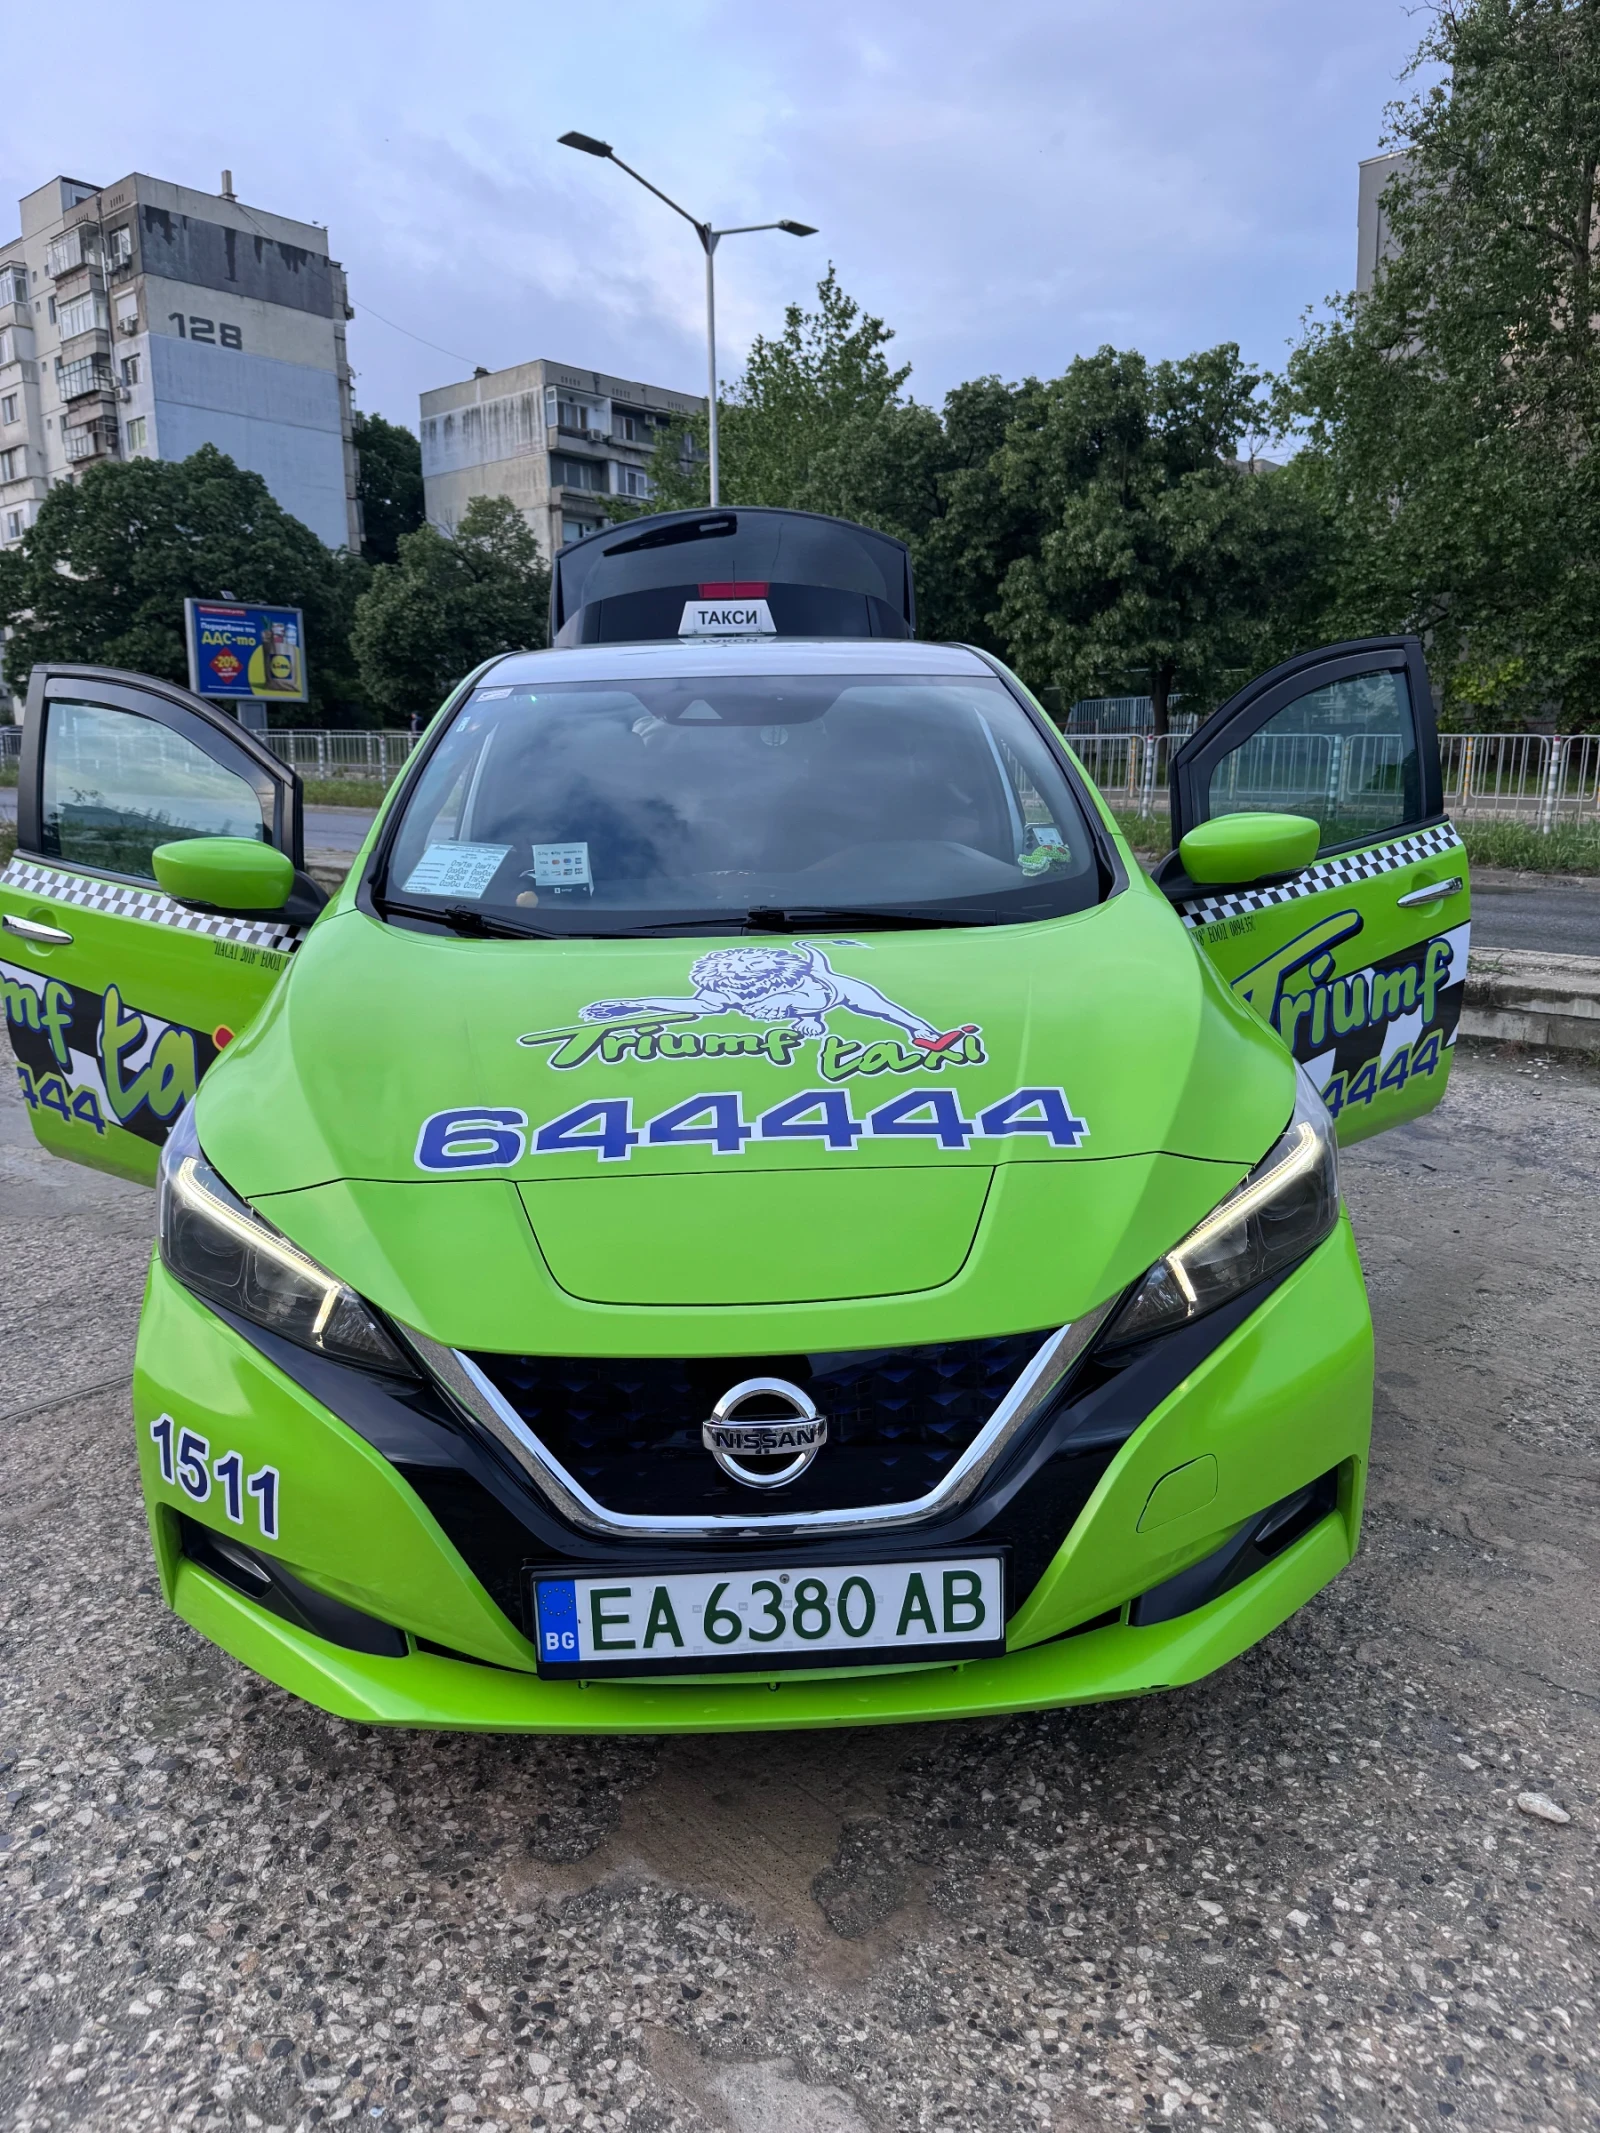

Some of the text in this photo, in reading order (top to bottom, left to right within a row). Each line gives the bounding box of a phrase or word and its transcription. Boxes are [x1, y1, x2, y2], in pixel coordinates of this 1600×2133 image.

[168, 311, 242, 350] 128
[698, 610, 757, 625] ТАКСИ
[1207, 922, 1229, 944] ЕООД
[260, 950, 282, 971] ЕООД
[517, 1012, 989, 1083] Triumf taxi
[414, 1087, 1090, 1172] 644444
[716, 1427, 815, 1449] NISSAN
[150, 1413, 280, 1541] 1511
[545, 1570, 987, 1651] BG EA 6380 AB
